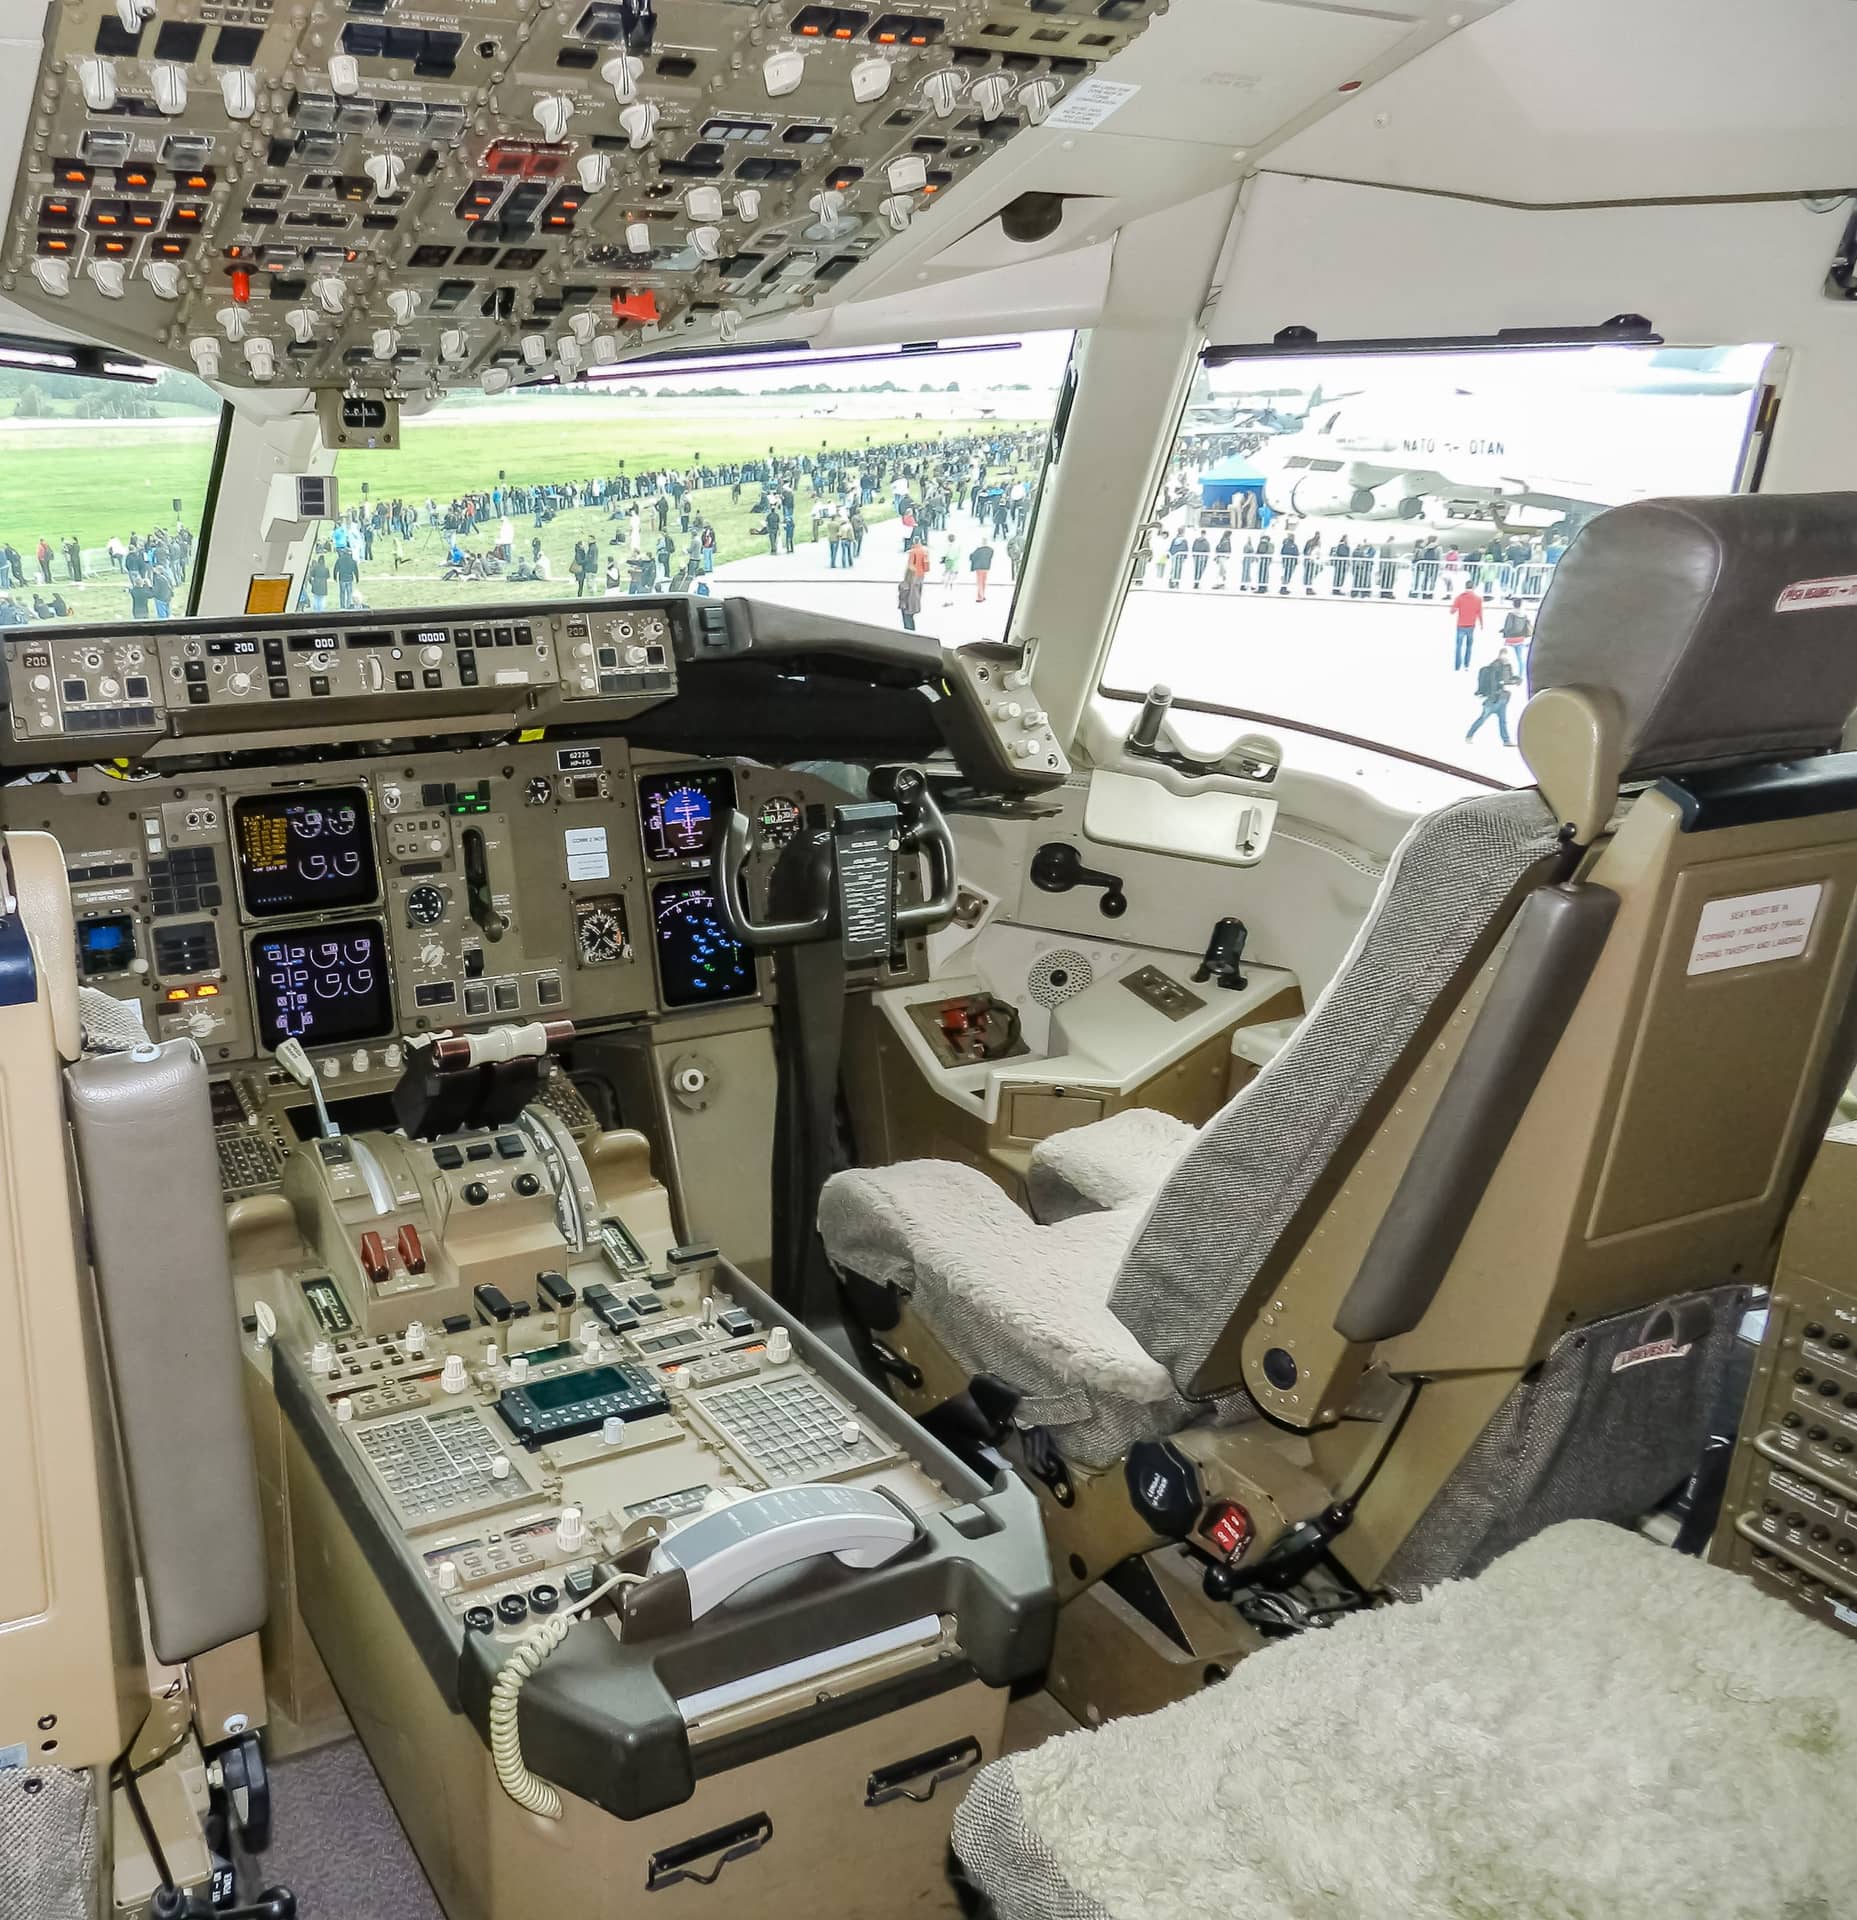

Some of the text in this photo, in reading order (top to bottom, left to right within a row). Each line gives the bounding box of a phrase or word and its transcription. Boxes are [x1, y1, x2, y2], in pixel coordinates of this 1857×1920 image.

[1403, 438, 1505, 455] NATO OTAN
[418, 632, 446, 643] 10000
[234, 642, 255, 653] 200
[314, 638, 335, 649] 000
[25, 656, 48, 667] 200
